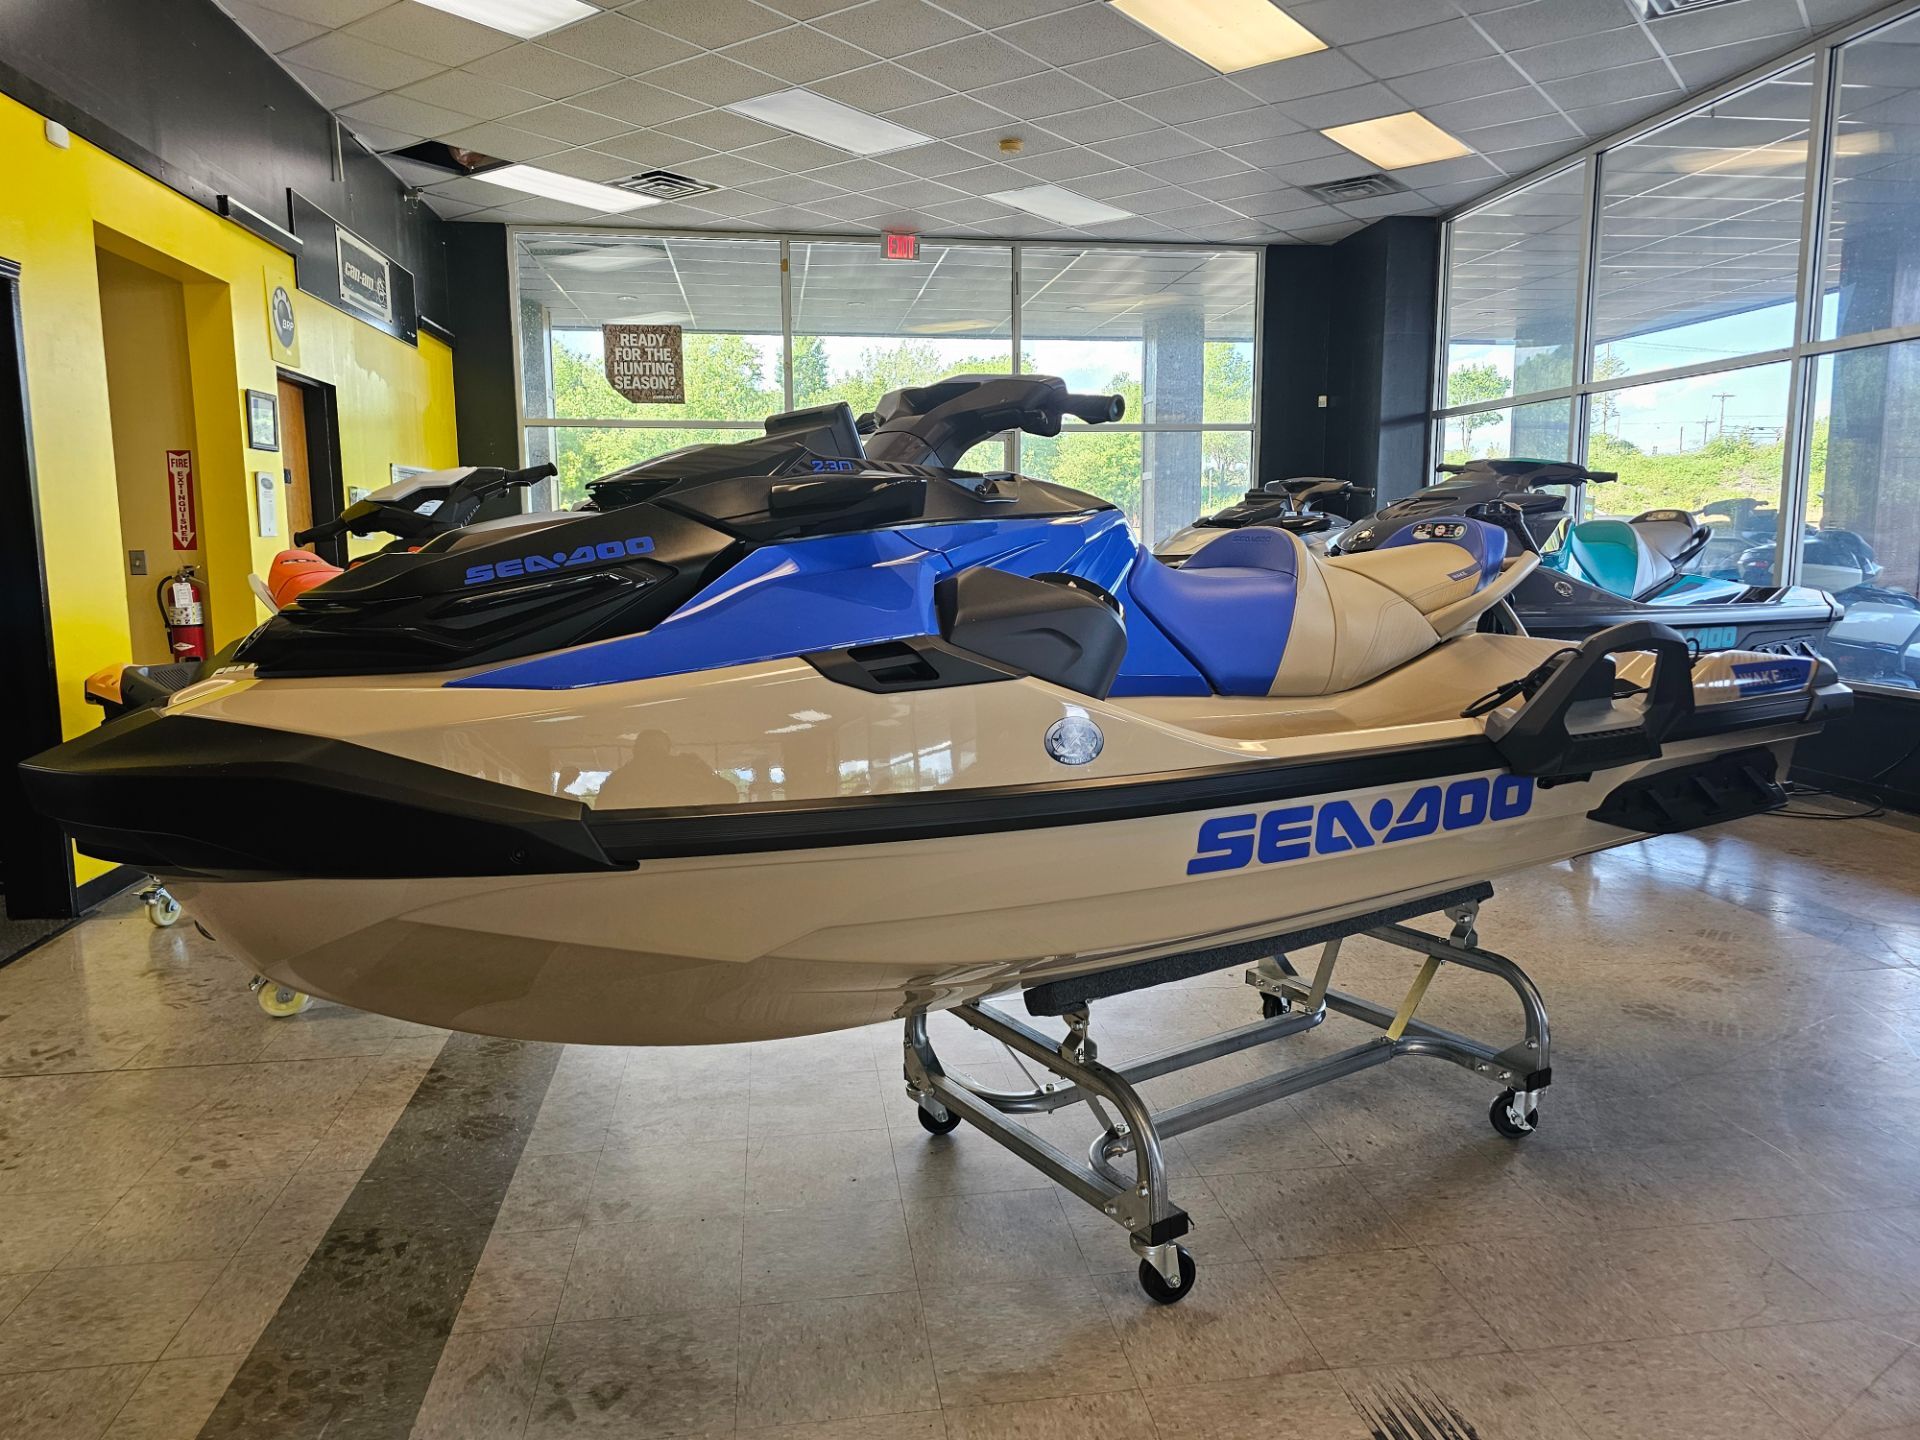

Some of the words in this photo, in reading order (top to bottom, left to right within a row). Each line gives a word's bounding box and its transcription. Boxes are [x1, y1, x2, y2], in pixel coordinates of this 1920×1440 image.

[887, 235, 915, 258] EXIT
[345, 262, 374, 290] can-am
[282, 319, 294, 331] BRP
[620, 333, 665, 347] READY
[615, 348, 641, 361] FOR
[645, 348, 672, 361] THE
[614, 362, 675, 375] HUNTING
[614, 376, 676, 390] SEASON?
[170, 458, 188, 468] FIRE
[811, 460, 852, 473] 230
[177, 470, 188, 542] EXTINGUISHER
